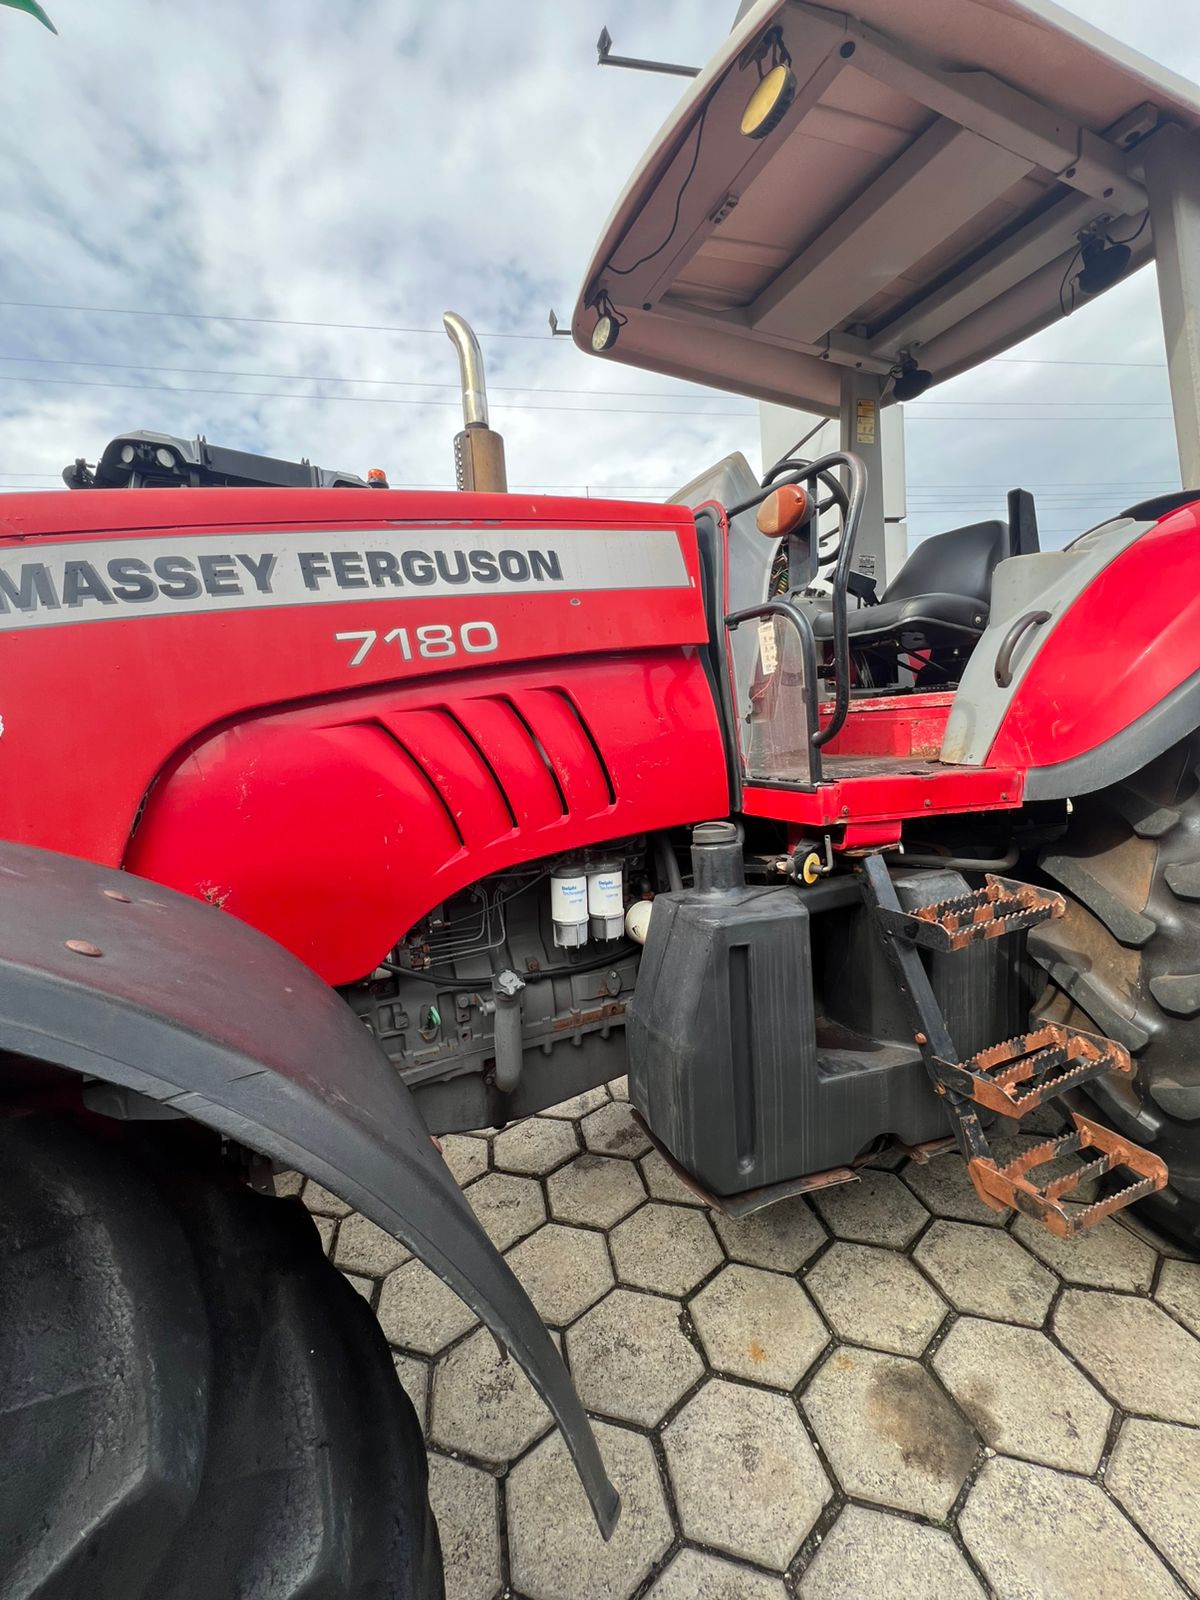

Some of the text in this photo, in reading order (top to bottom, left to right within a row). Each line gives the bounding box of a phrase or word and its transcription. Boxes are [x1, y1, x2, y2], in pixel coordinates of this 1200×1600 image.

[0, 550, 564, 614] MASSEY FERGUSON
[334, 620, 499, 667] 7180
